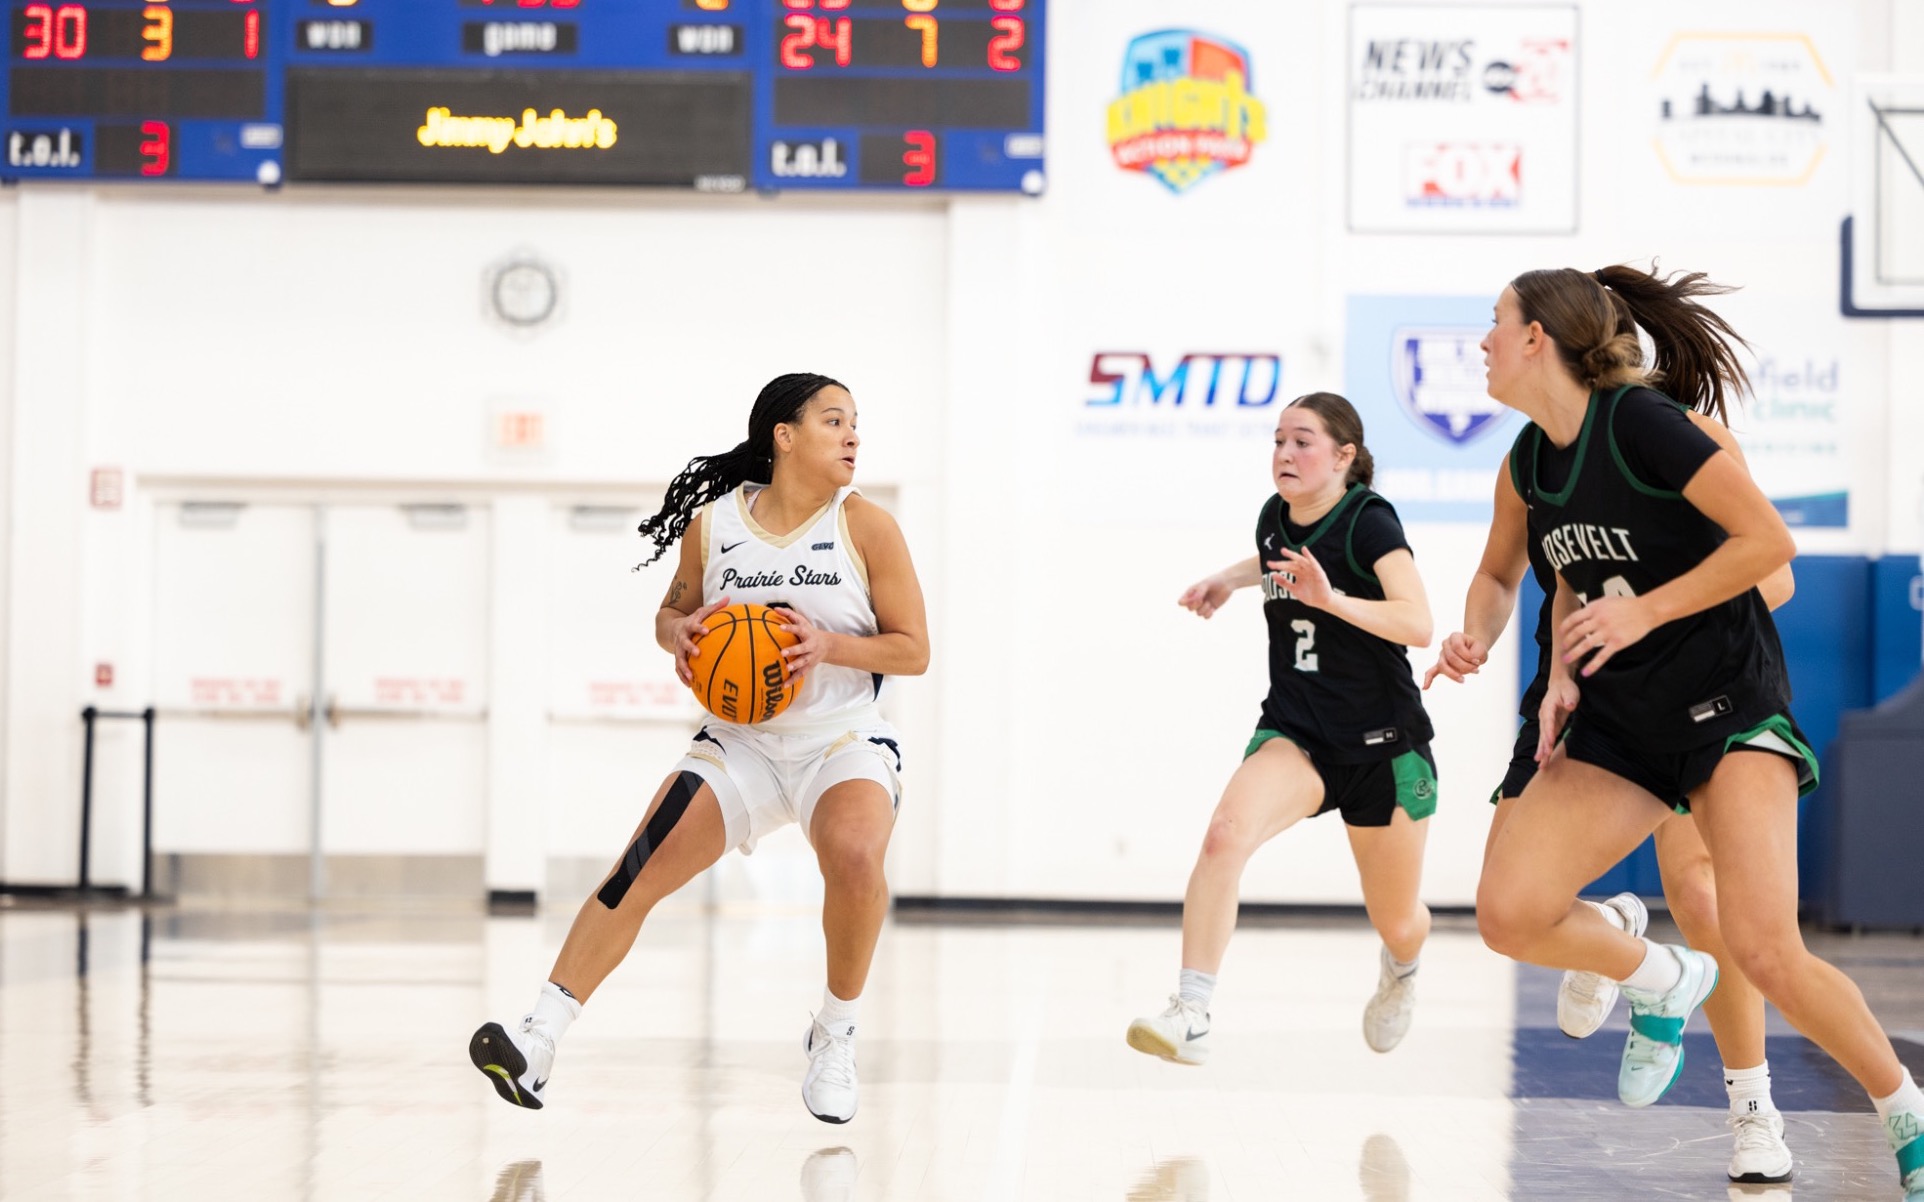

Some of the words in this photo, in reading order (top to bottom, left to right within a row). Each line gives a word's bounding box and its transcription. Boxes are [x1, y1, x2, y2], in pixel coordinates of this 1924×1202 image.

[23, 3, 87, 59] 30
[141, 5, 173, 61] 3
[244, 9, 259, 59] 1
[483, 22, 557, 56] game
[781, 13, 852, 69] 24
[905, 14, 938, 68] 7
[987, 15, 1025, 71] 2
[1363, 39, 1475, 73] NEWS
[1354, 77, 1474, 102] CHANNEL
[140, 121, 170, 176] 3
[417, 106, 515, 153] Jimmy
[514, 108, 617, 148] John's
[903, 130, 936, 186] 3
[1407, 146, 1518, 198] FOX
[1086, 353, 1281, 407] SMTD
[1748, 356, 1840, 398] field
[1541, 523, 1640, 571] OSEVELT
[719, 567, 784, 591] Prairie
[788, 564, 842, 587] Stars
[1290, 618, 1319, 672] 2
